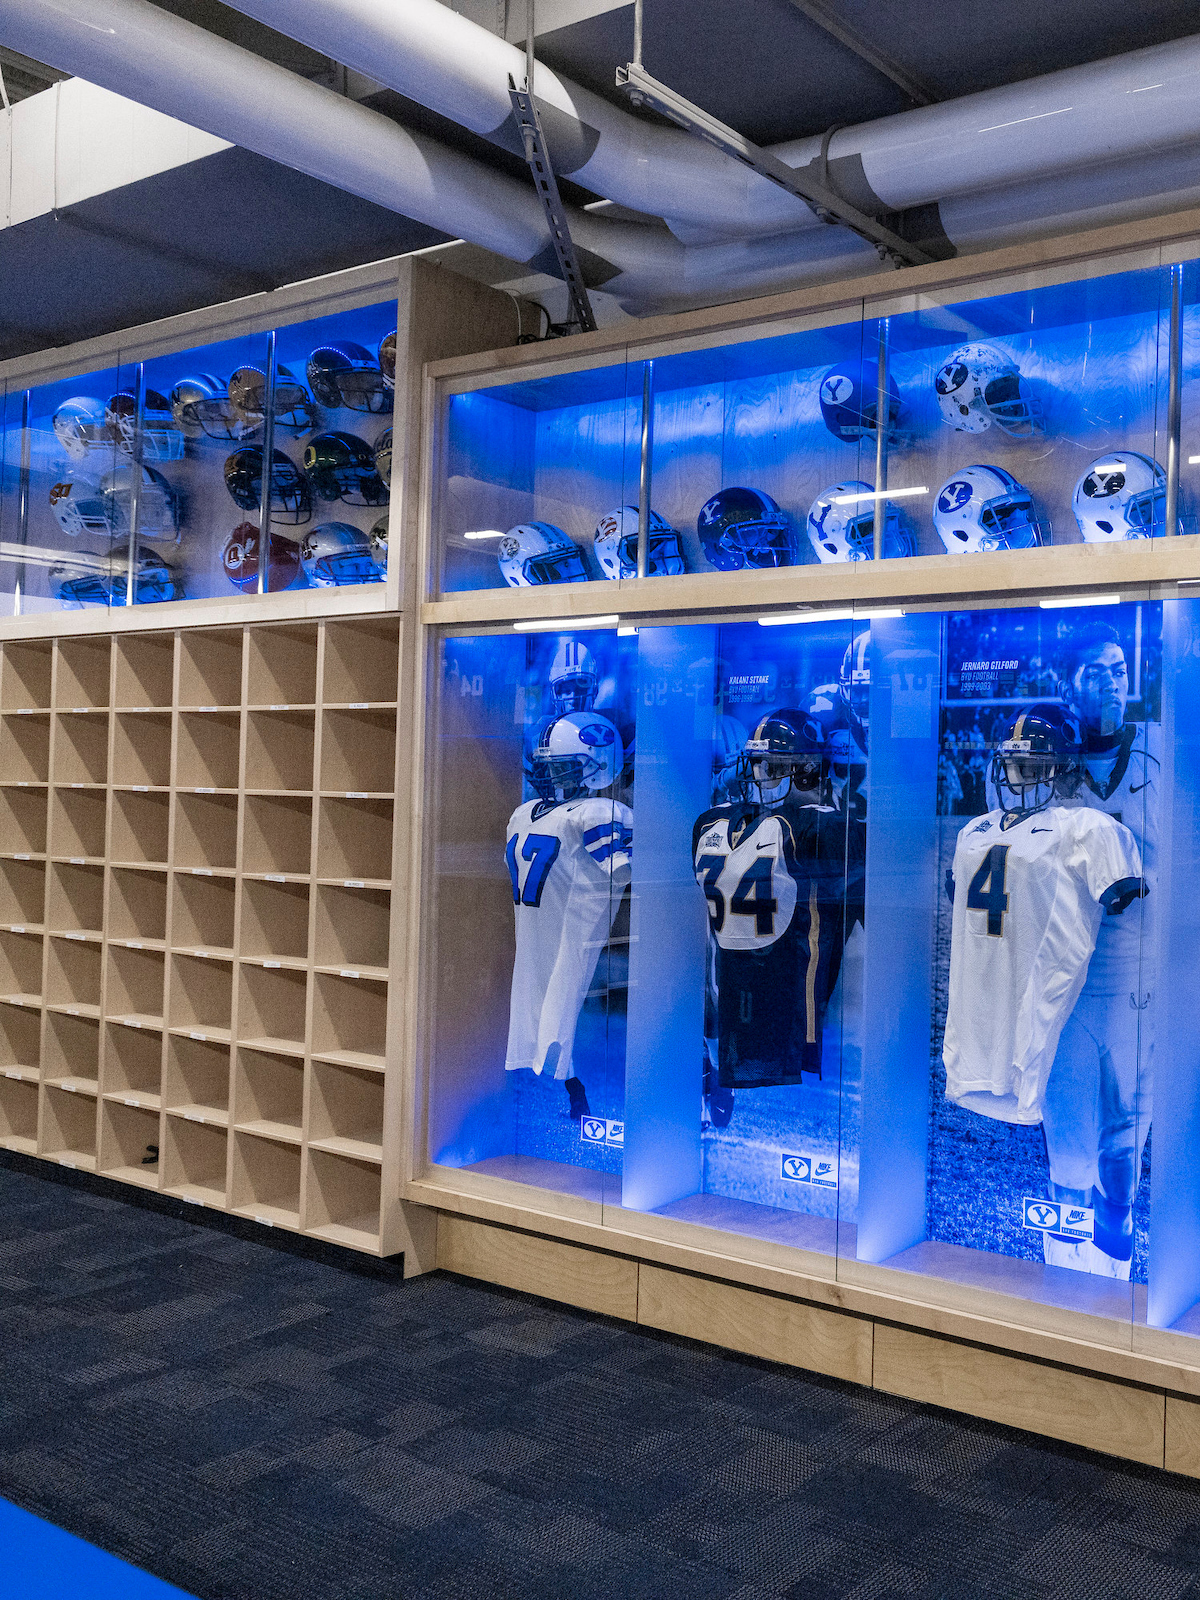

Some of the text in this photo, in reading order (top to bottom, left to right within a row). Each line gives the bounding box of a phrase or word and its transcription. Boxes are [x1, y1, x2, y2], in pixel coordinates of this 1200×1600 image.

[825, 377, 844, 402] Y
[937, 364, 962, 393] Y
[1089, 470, 1118, 495] Y
[940, 483, 966, 508] Y
[702, 499, 721, 524] Y
[808, 503, 832, 541] Y
[961, 660, 1019, 671] JERNARD GILFORD
[972, 671, 999, 681] FOOTBALL
[584, 725, 609, 745] Y
[696, 853, 779, 938] 34
[966, 843, 1012, 938] 4
[587, 1122, 602, 1138] Y
[788, 1159, 805, 1177] Y
[1032, 1206, 1053, 1225] Y
[1069, 1209, 1086, 1220] NIKE
